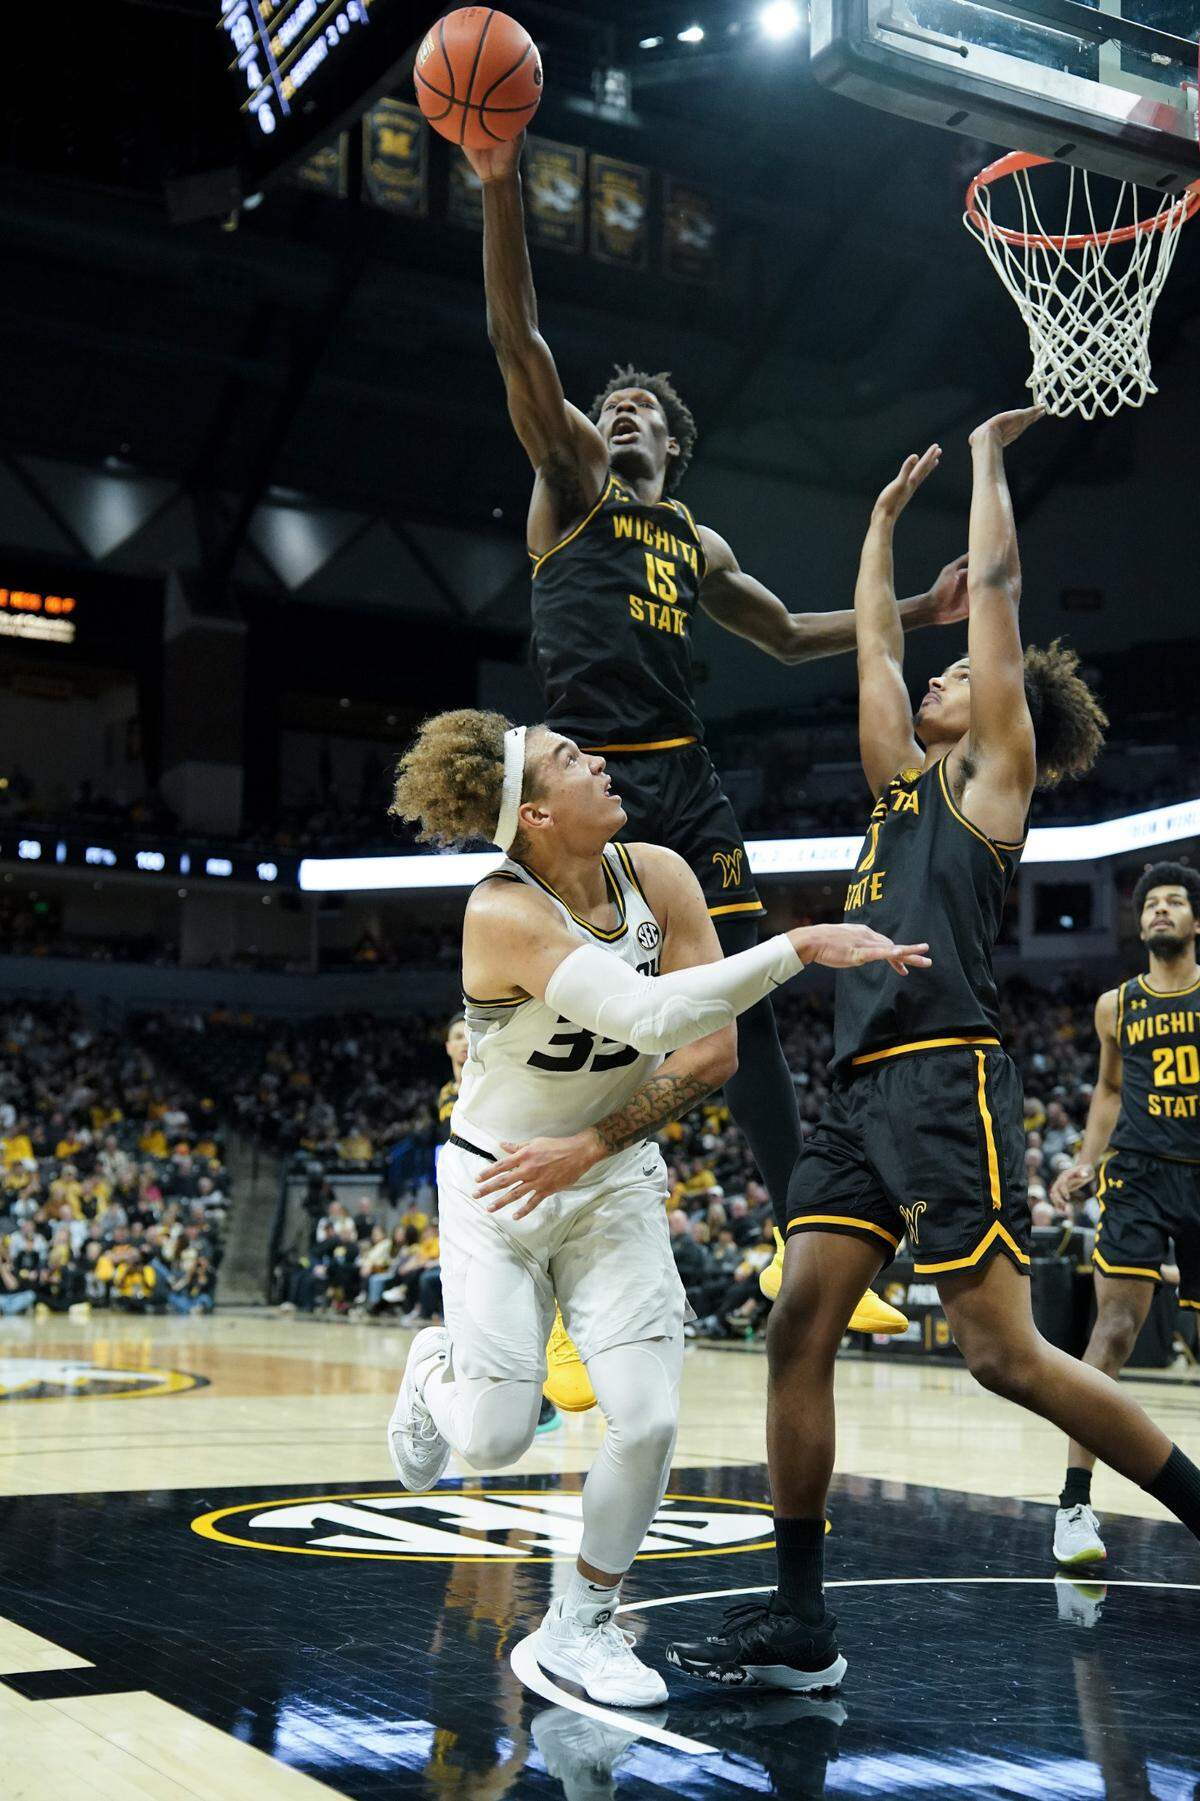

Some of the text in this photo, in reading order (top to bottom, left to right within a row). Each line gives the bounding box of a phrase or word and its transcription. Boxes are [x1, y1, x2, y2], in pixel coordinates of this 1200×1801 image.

[644, 551, 679, 605] 15
[629, 594, 689, 637] STATE
[638, 922, 660, 949] SEC
[1151, 1044, 1200, 1088] 20
[1147, 1093, 1200, 1118] STAT
